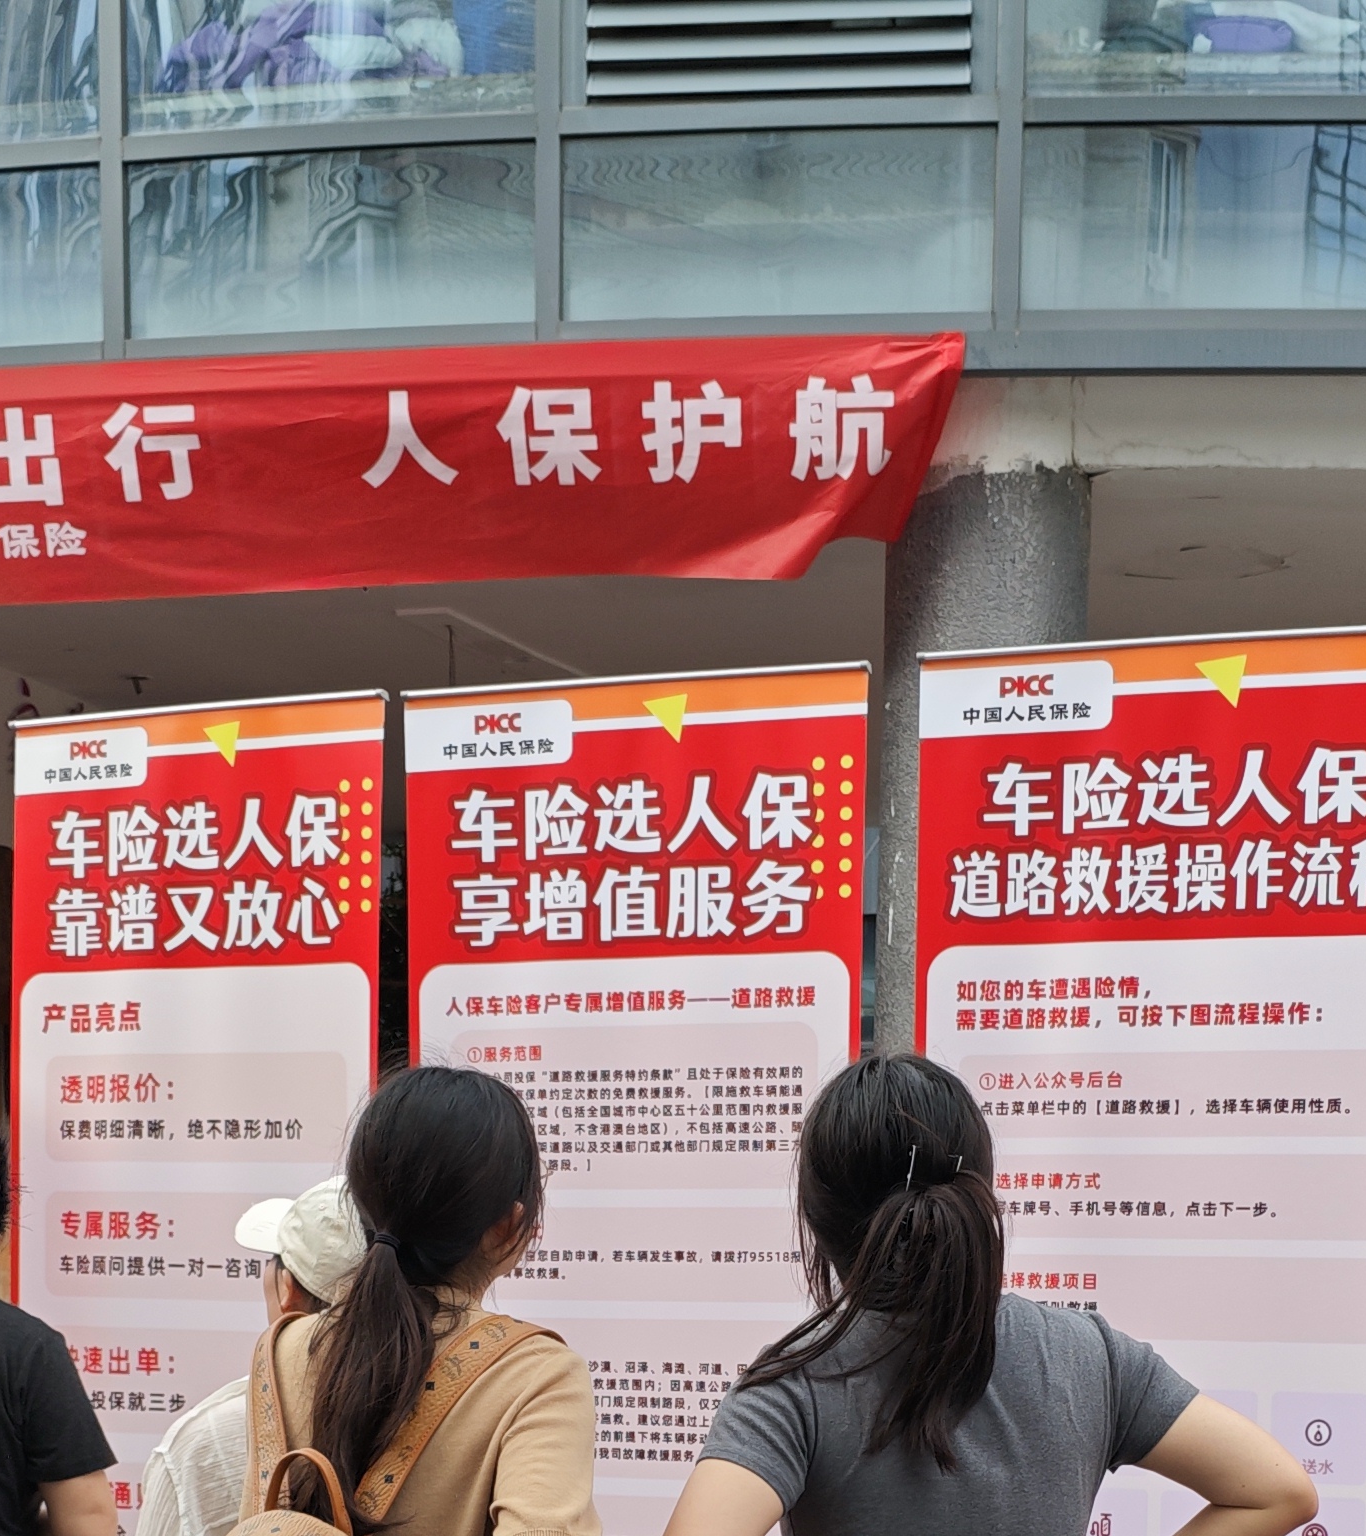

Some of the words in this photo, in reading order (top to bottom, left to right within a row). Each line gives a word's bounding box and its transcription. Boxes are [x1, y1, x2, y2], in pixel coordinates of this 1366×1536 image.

[361, 373, 895, 487] 人保护航
[1000, 674, 1054, 699] PICC
[474, 713, 521, 735] PICC
[962, 702, 1092, 725] 中国人民保险
[70, 740, 107, 760] PICC
[443, 738, 554, 760] 中国人民保险
[44, 763, 133, 784] 中国人民保险
[451, 772, 812, 863] 车险选人保
[49, 795, 340, 879] 车险选人保
[49, 877, 340, 956] 靠谱又放心
[452, 860, 811, 948] 享增值服务
[446, 985, 816, 1016] 人保车险客户专属增值服务——道路救援
[957, 976, 1152, 1003] 如您的车遭遇险情，
[42, 1001, 142, 1034] 产品亮点
[956, 1002, 1324, 1031] 需要道路救援，可按下图流程操作：
[467, 1045, 542, 1063] ①服务范围
[60, 1073, 174, 1104] 透明报价：
[979, 1071, 1123, 1091] ①进入公众号后台
[60, 1118, 303, 1141] 保费明细清晰，绝不隐形加价
[996, 1173, 1101, 1190] 选择申请方式
[60, 1211, 174, 1240] 专属服务：
[59, 1255, 272, 1279] 车险顾问提供一对一咨询
[1302, 1459, 1334, 1475] 送水
